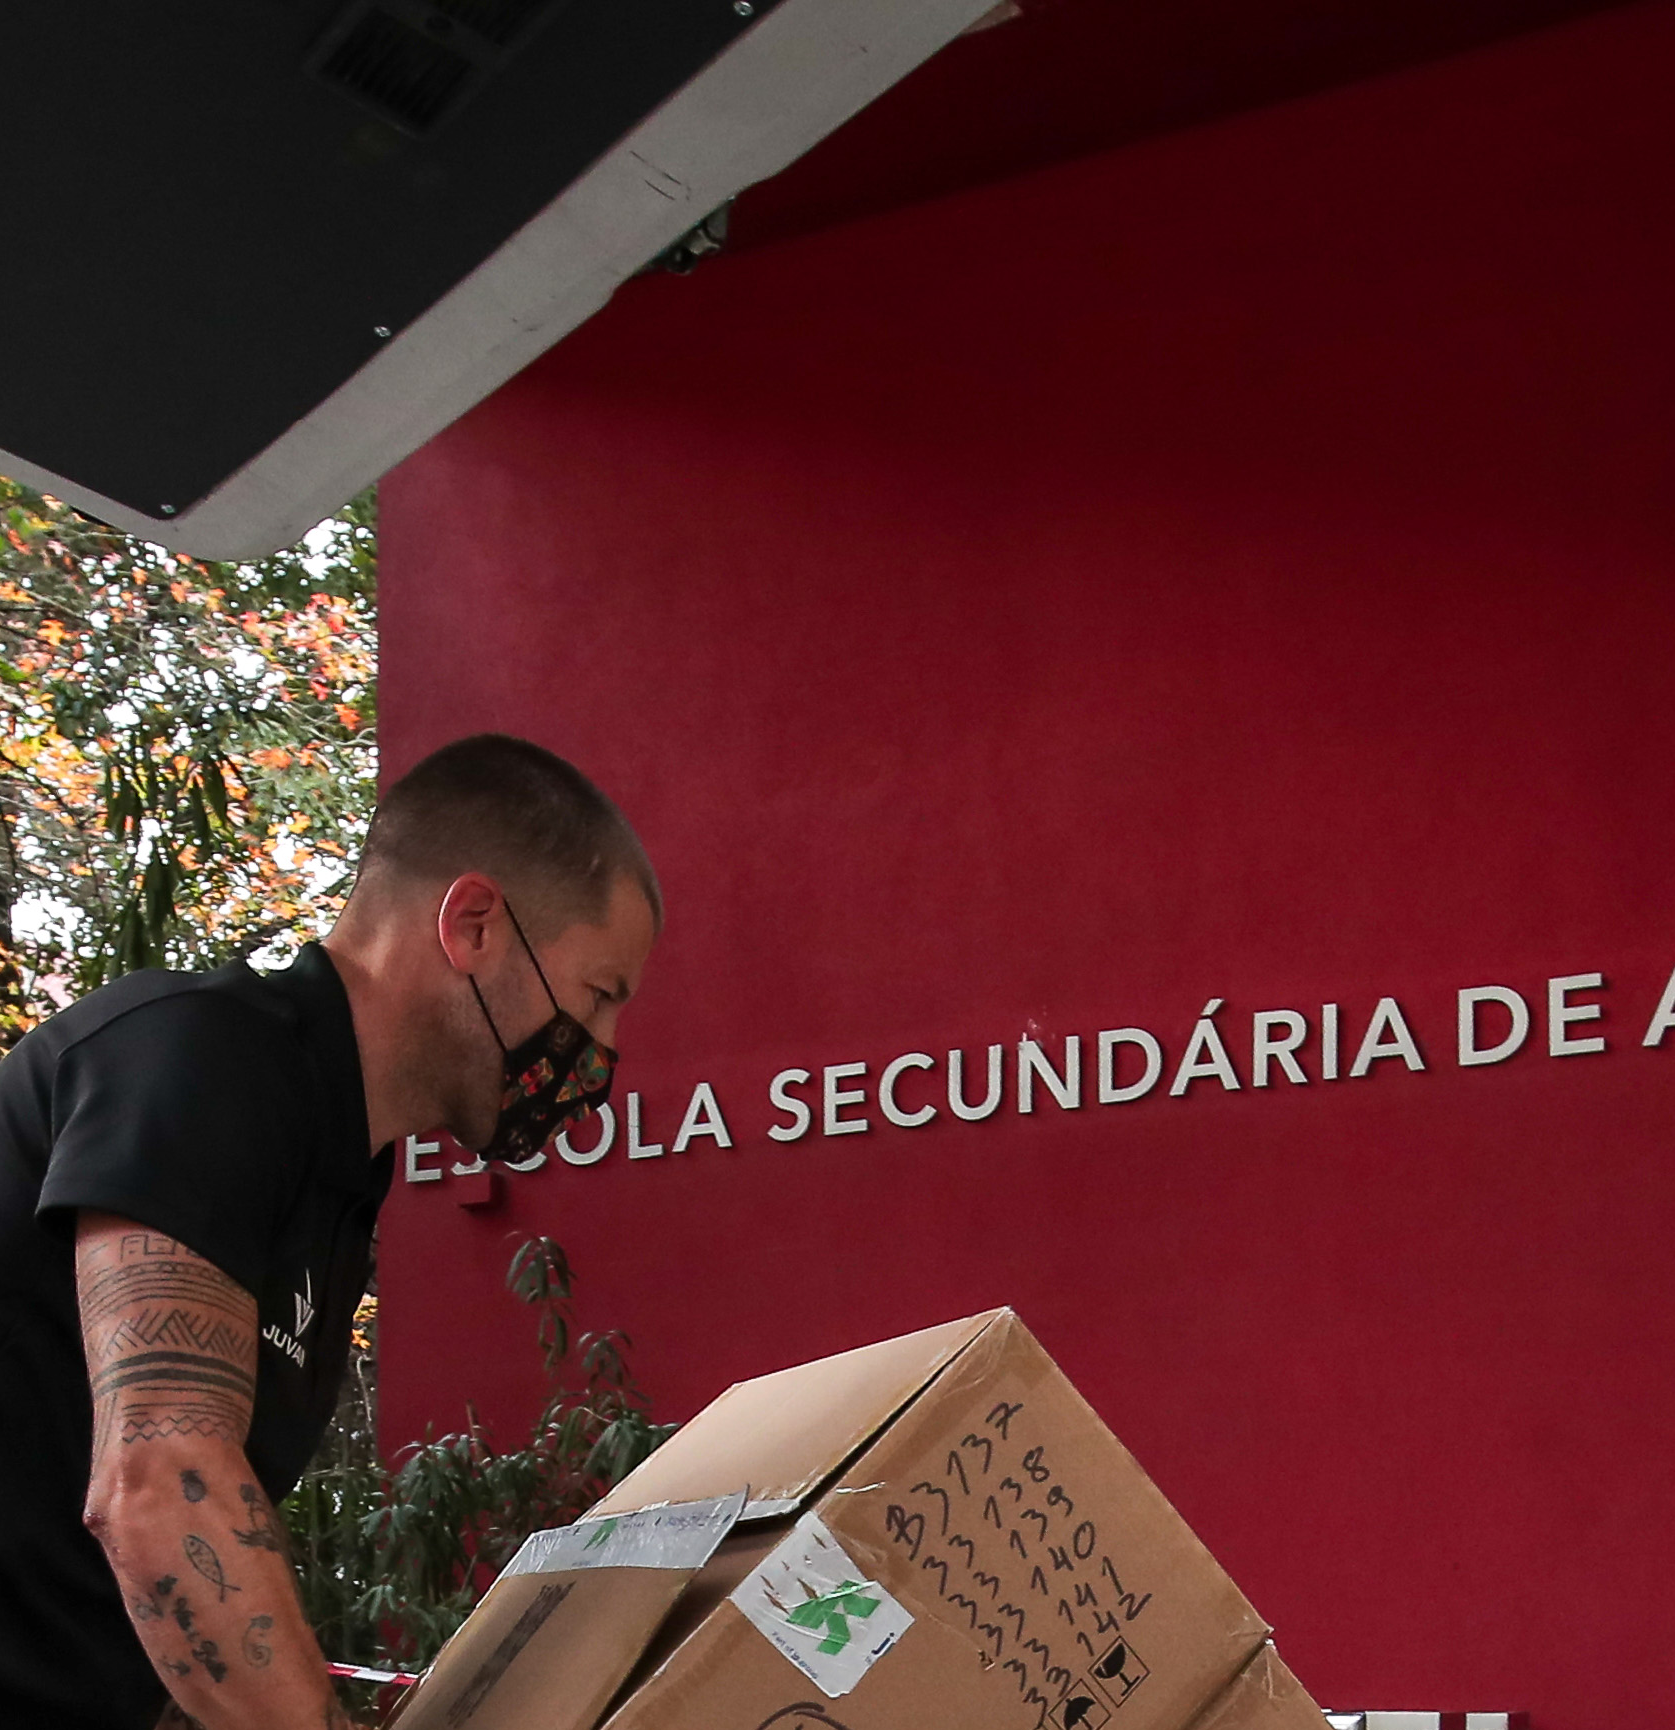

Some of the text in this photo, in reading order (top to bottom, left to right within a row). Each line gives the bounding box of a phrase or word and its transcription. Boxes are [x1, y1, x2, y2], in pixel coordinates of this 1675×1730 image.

[404, 1082, 733, 1183] EOLA
[766, 998, 1424, 1142] SECUNDÁRIA
[1457, 973, 1605, 1067] DE
